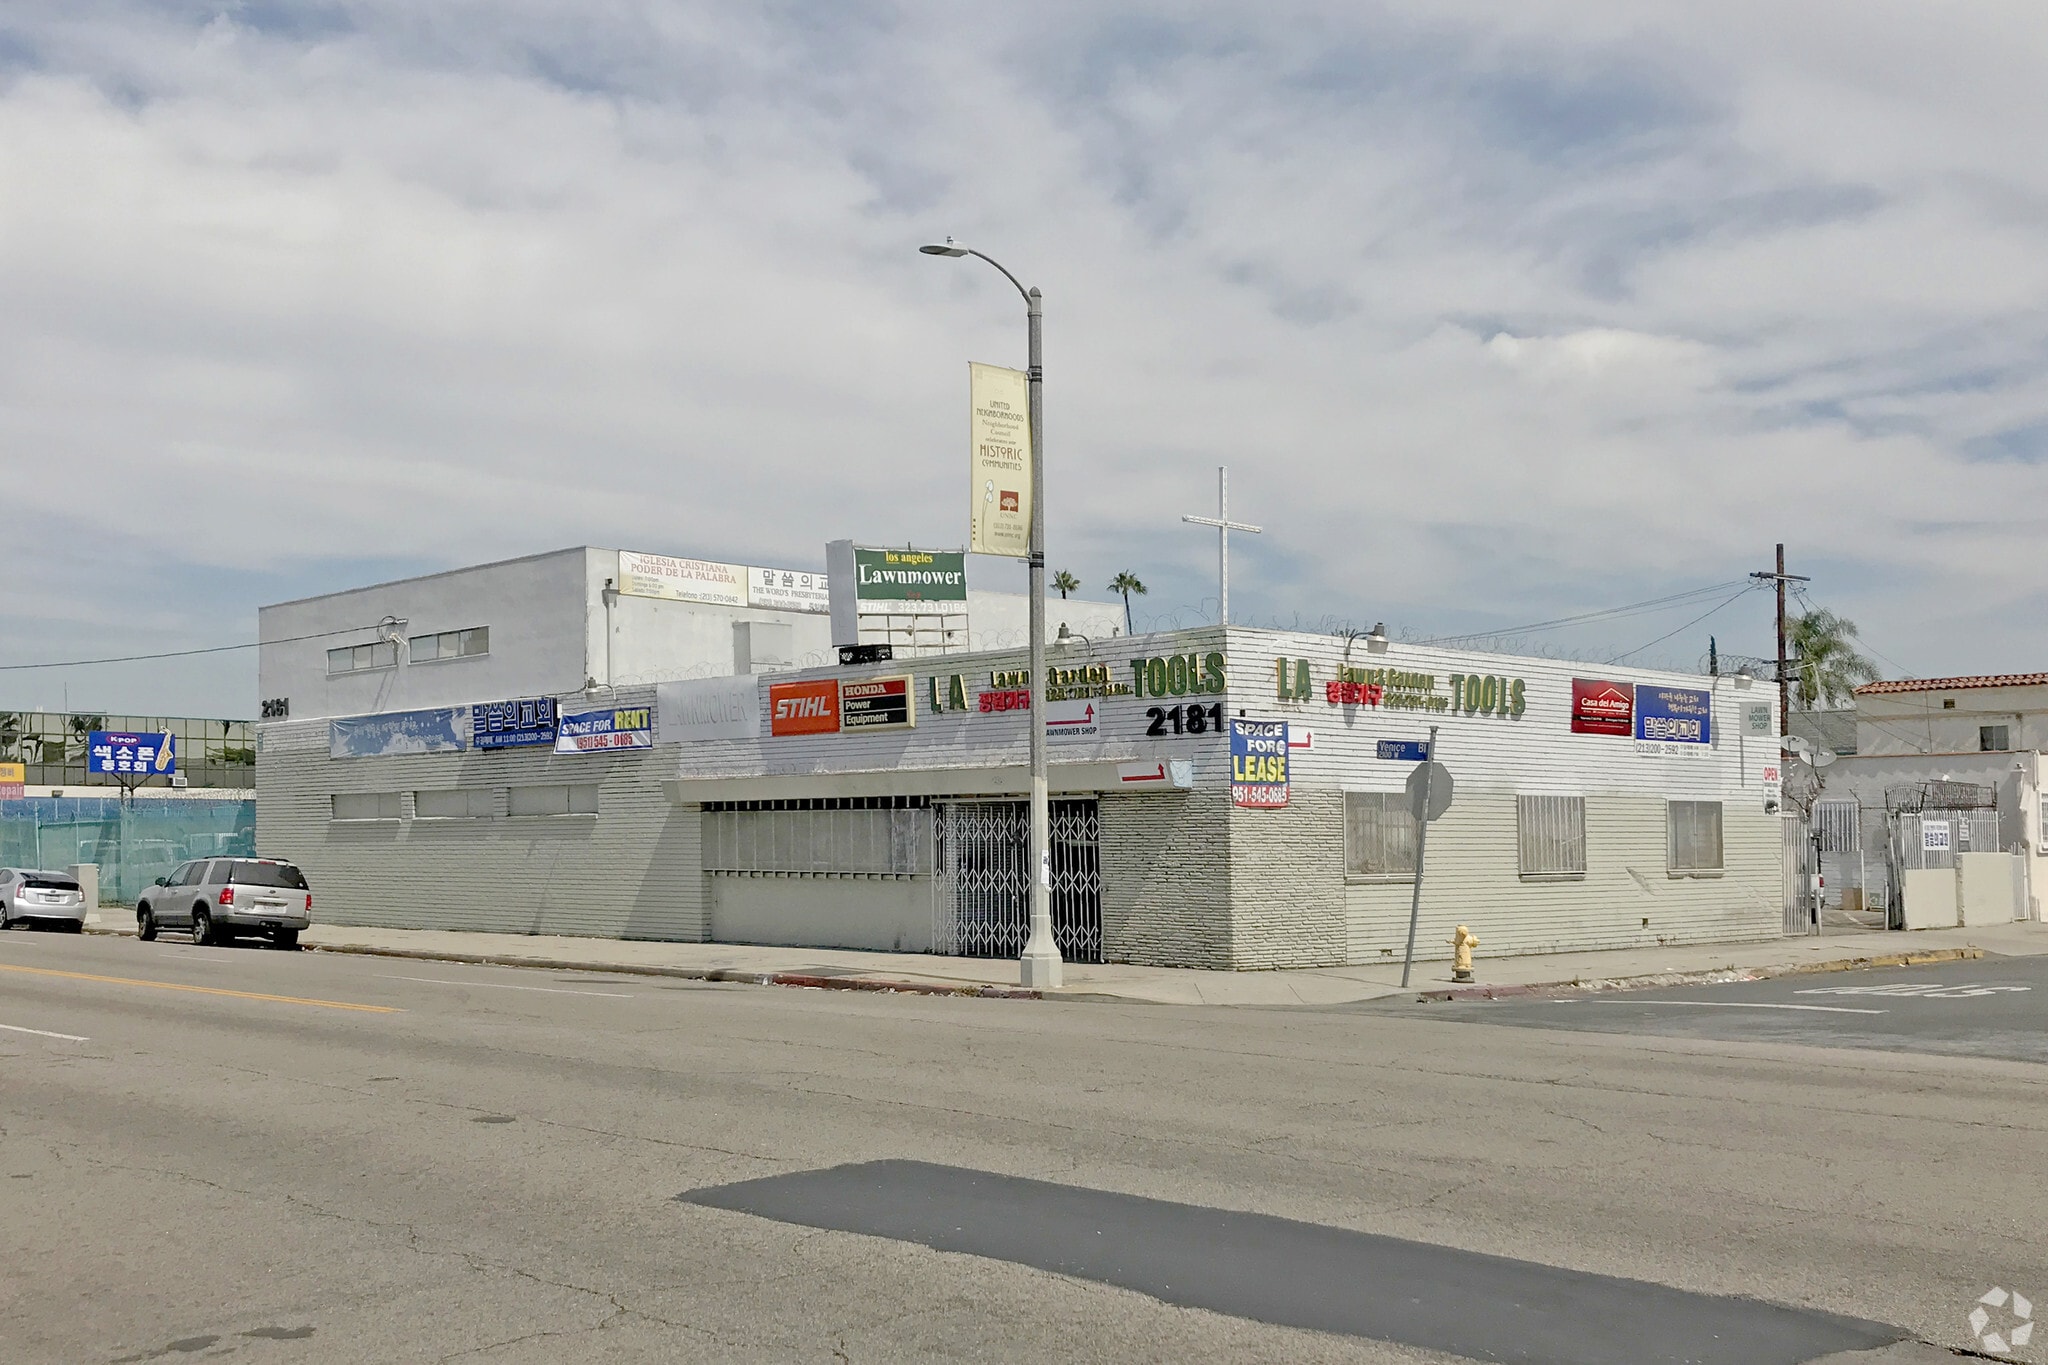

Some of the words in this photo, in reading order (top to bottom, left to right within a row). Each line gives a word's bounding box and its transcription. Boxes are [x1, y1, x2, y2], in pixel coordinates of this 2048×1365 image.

[989, 400, 1010, 410] UNITED
[980, 443, 1023, 461] HISTORIC
[981, 459, 1022, 471] COMMUNITIES
[639, 555, 677, 568] IGLESIA
[679, 559, 728, 574] CRISTIANA
[885, 551, 899, 563] los
[901, 552, 933, 565] angeles
[631, 563, 663, 576] PODER
[666, 568, 679, 577] DE
[681, 570, 693, 579] LA
[695, 572, 737, 584] PALABRA
[858, 564, 962, 585] Lawnmower
[752, 586, 765, 594] THE
[765, 587, 789, 597] WORD'S
[791, 590, 830, 600] PRESBYTERIA
[858, 602, 891, 612] STIHL
[990, 670, 1031, 688] Lawn
[1130, 652, 1227, 697] TOOLS
[1276, 657, 1312, 698] LA
[844, 683, 887, 697] HONDA
[929, 673, 968, 713] LA
[1450, 673, 1525, 715] TOOLS
[775, 695, 831, 719] STIHL
[845, 700, 871, 711] Power
[1581, 697, 1598, 706] Casa
[1599, 699, 1609, 707] del
[1610, 699, 1630, 711] Amigo
[1751, 706, 1768, 714] LAWN
[561, 721, 591, 735] SPACE
[592, 719, 611, 732] FOR
[614, 709, 649, 730] RENT
[846, 712, 889, 725] Equipment
[1146, 703, 1225, 736] 2181
[1749, 713, 1771, 722] MOWER
[1046, 727, 1080, 737] AWNMOWER
[1081, 726, 1098, 735] SHOP
[1234, 722, 1283, 737] SPACE
[1751, 722, 1768, 730] SHOP
[593, 734, 608, 747] 545
[1247, 739, 1276, 752] FOR
[1379, 741, 1406, 753] Venice
[1233, 755, 1286, 782] LEASE
[1763, 767, 1778, 781] OPEN
[0, 783, 24, 800] epair
